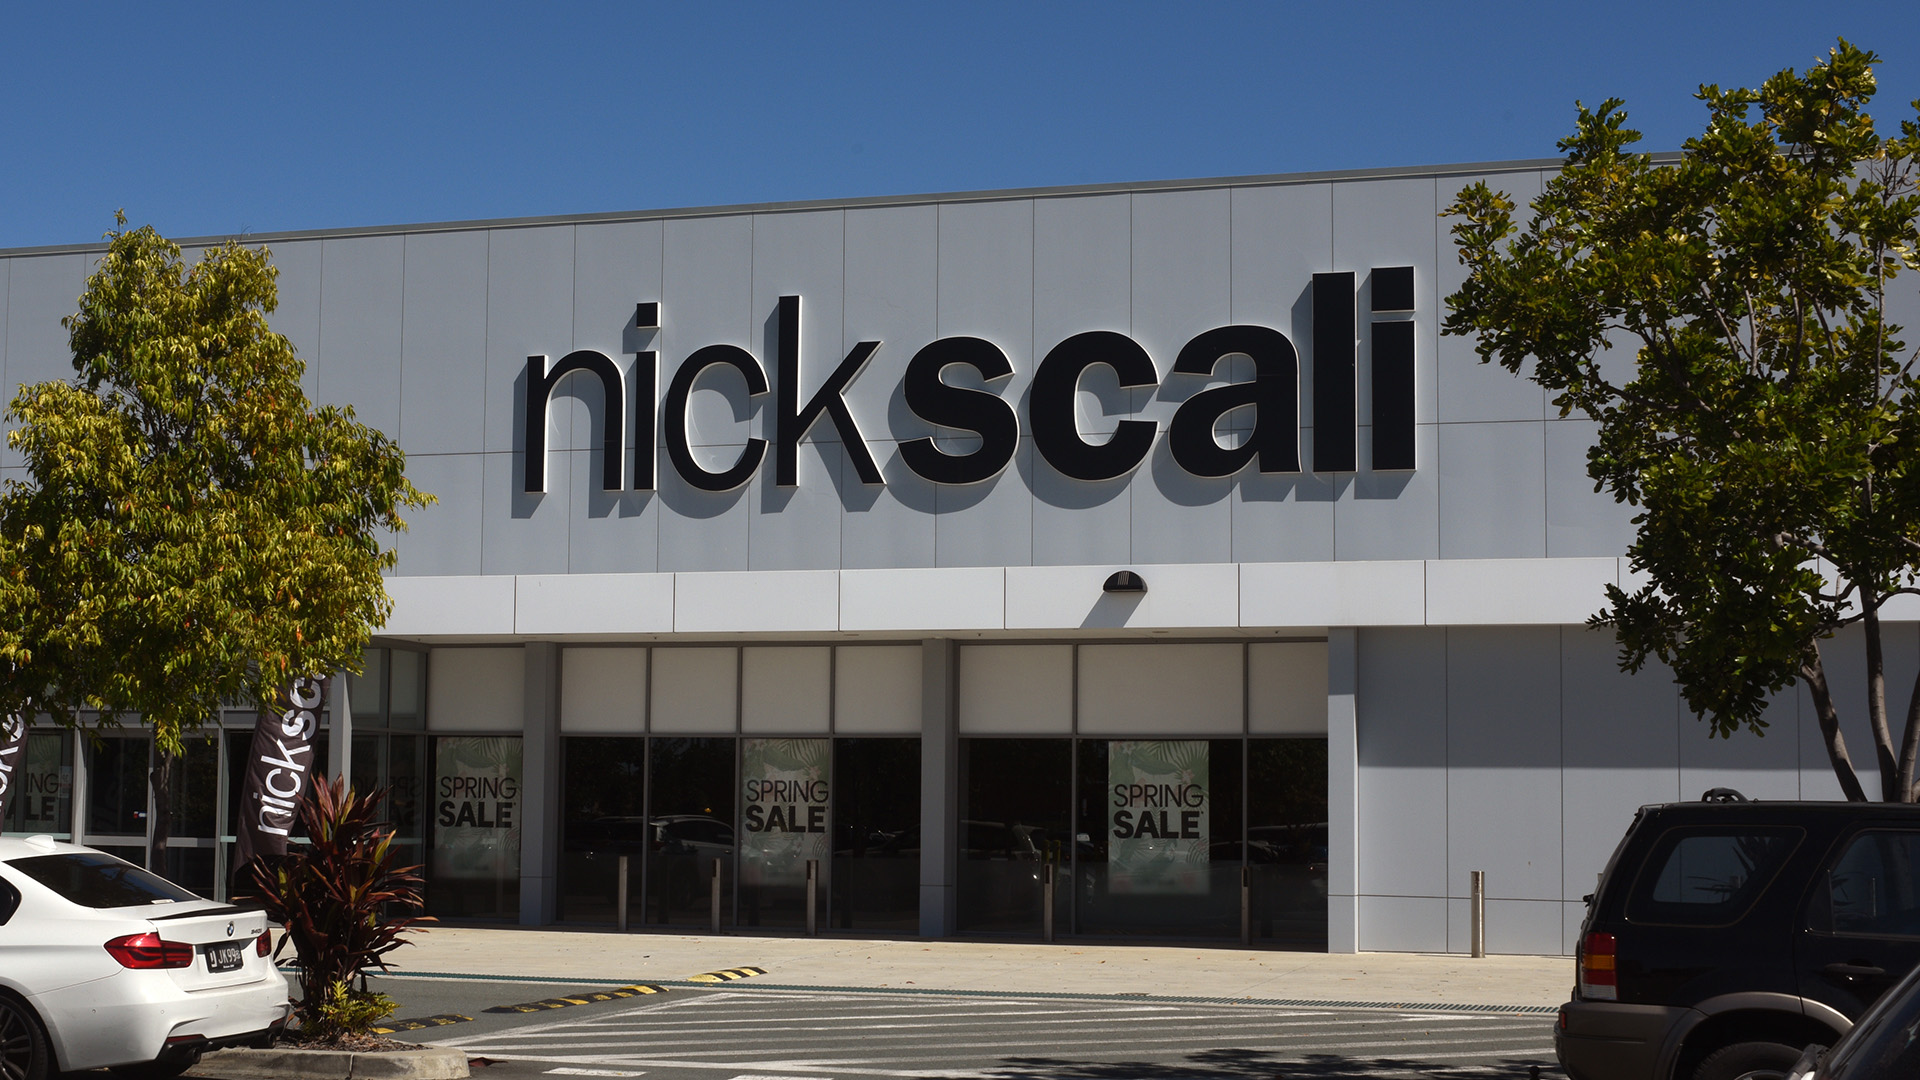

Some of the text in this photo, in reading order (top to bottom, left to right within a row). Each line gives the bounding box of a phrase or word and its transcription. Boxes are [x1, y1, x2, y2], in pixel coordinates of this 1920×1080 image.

[524, 266, 1417, 494] nickscali
[253, 669, 326, 836] nicksc
[440, 776, 517, 799] SPRING
[746, 780, 829, 803] SPRING
[1113, 784, 1204, 808] SPRING
